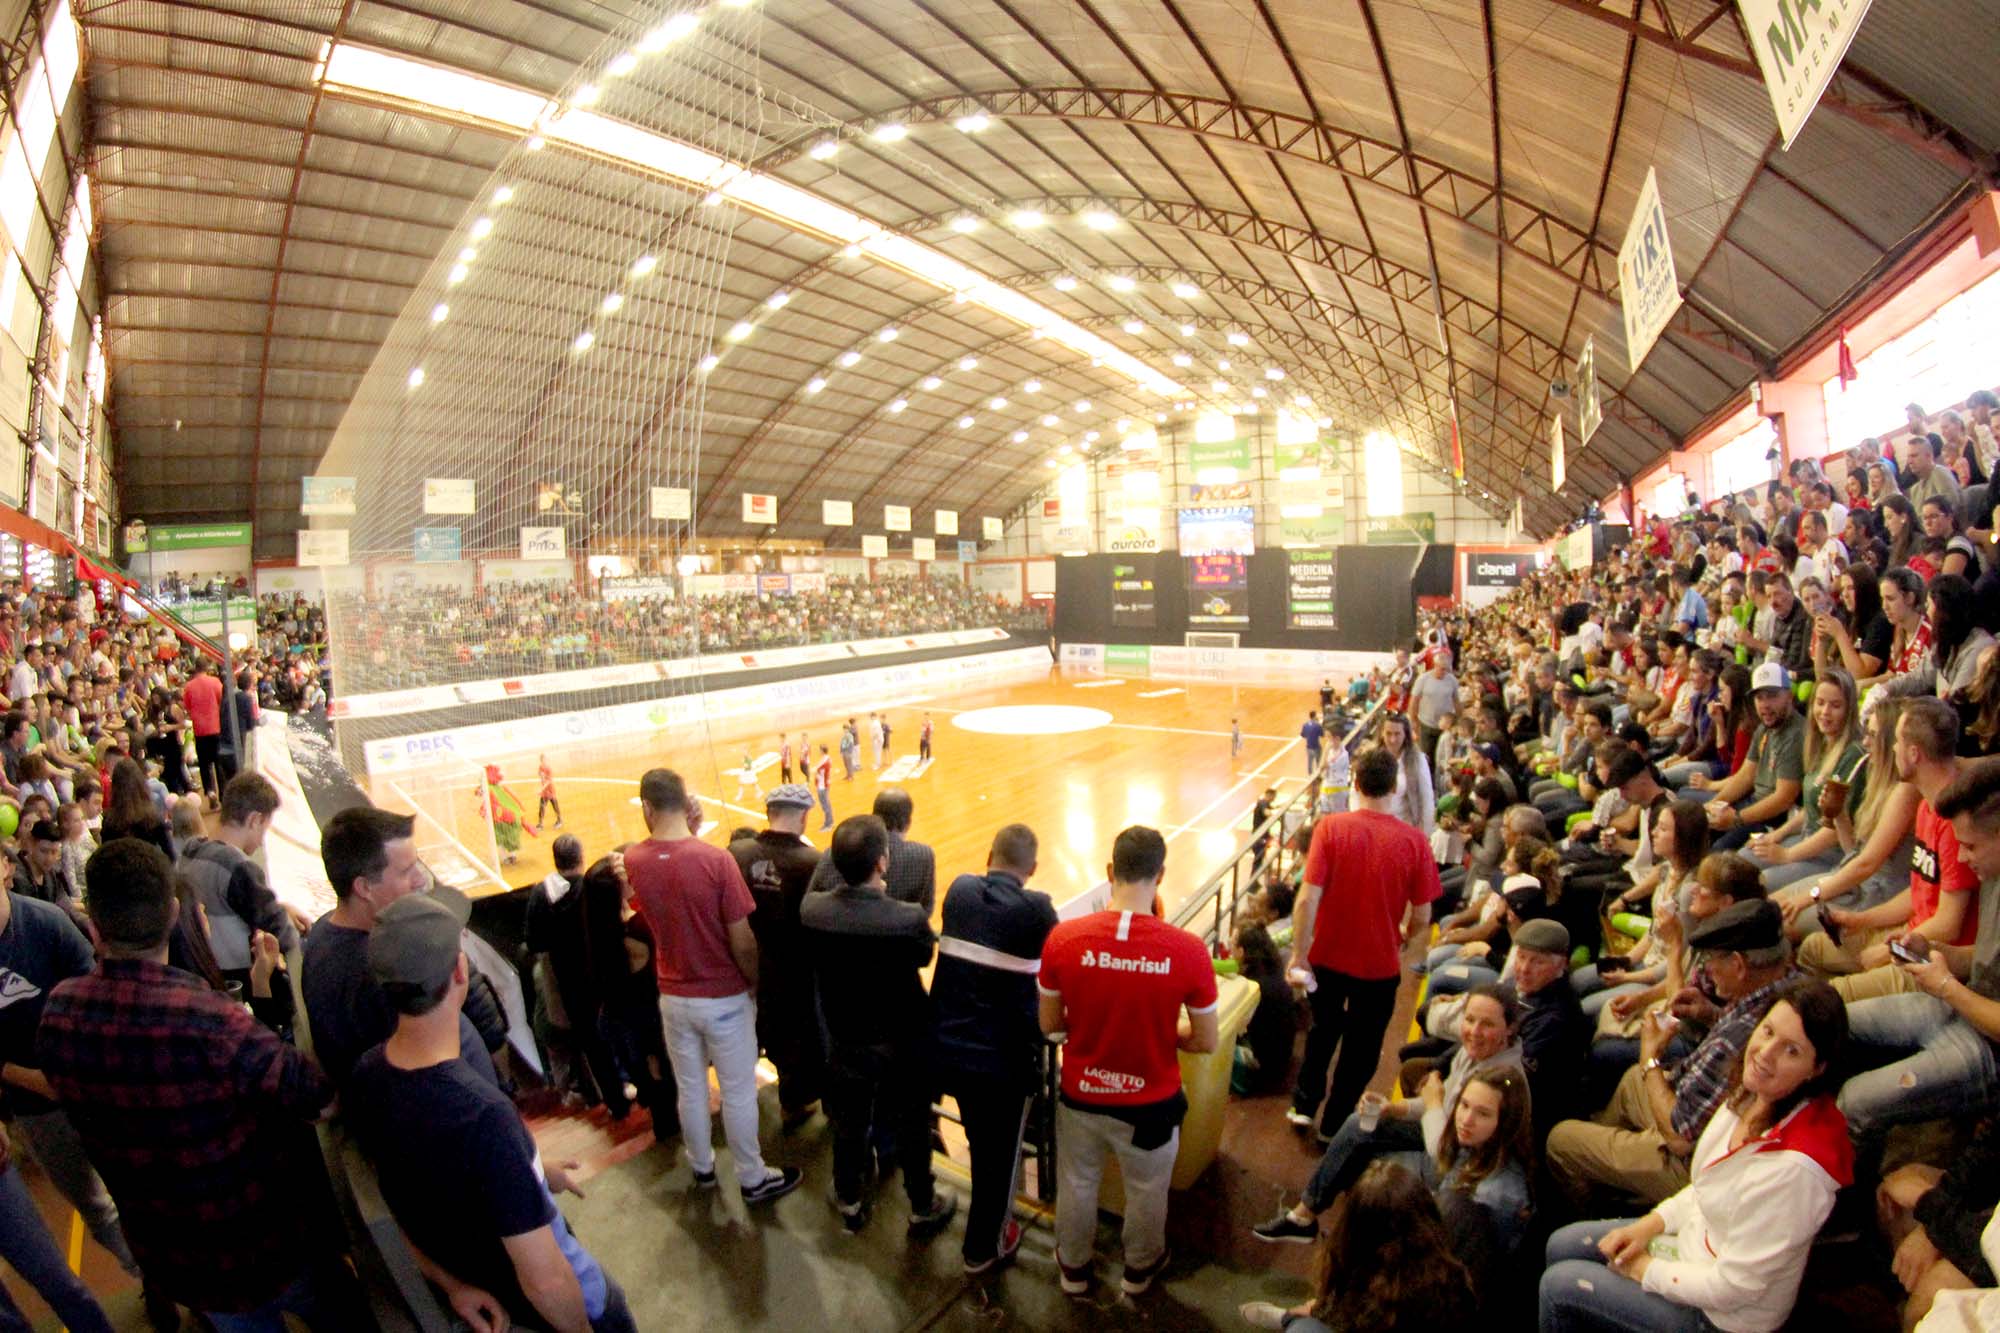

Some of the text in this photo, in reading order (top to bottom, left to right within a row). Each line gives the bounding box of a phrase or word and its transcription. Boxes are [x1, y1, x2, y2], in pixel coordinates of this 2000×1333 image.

[1633, 204, 1665, 290] URI
[1111, 539, 1156, 551] aurora
[1098, 952, 1171, 975] Banrisul
